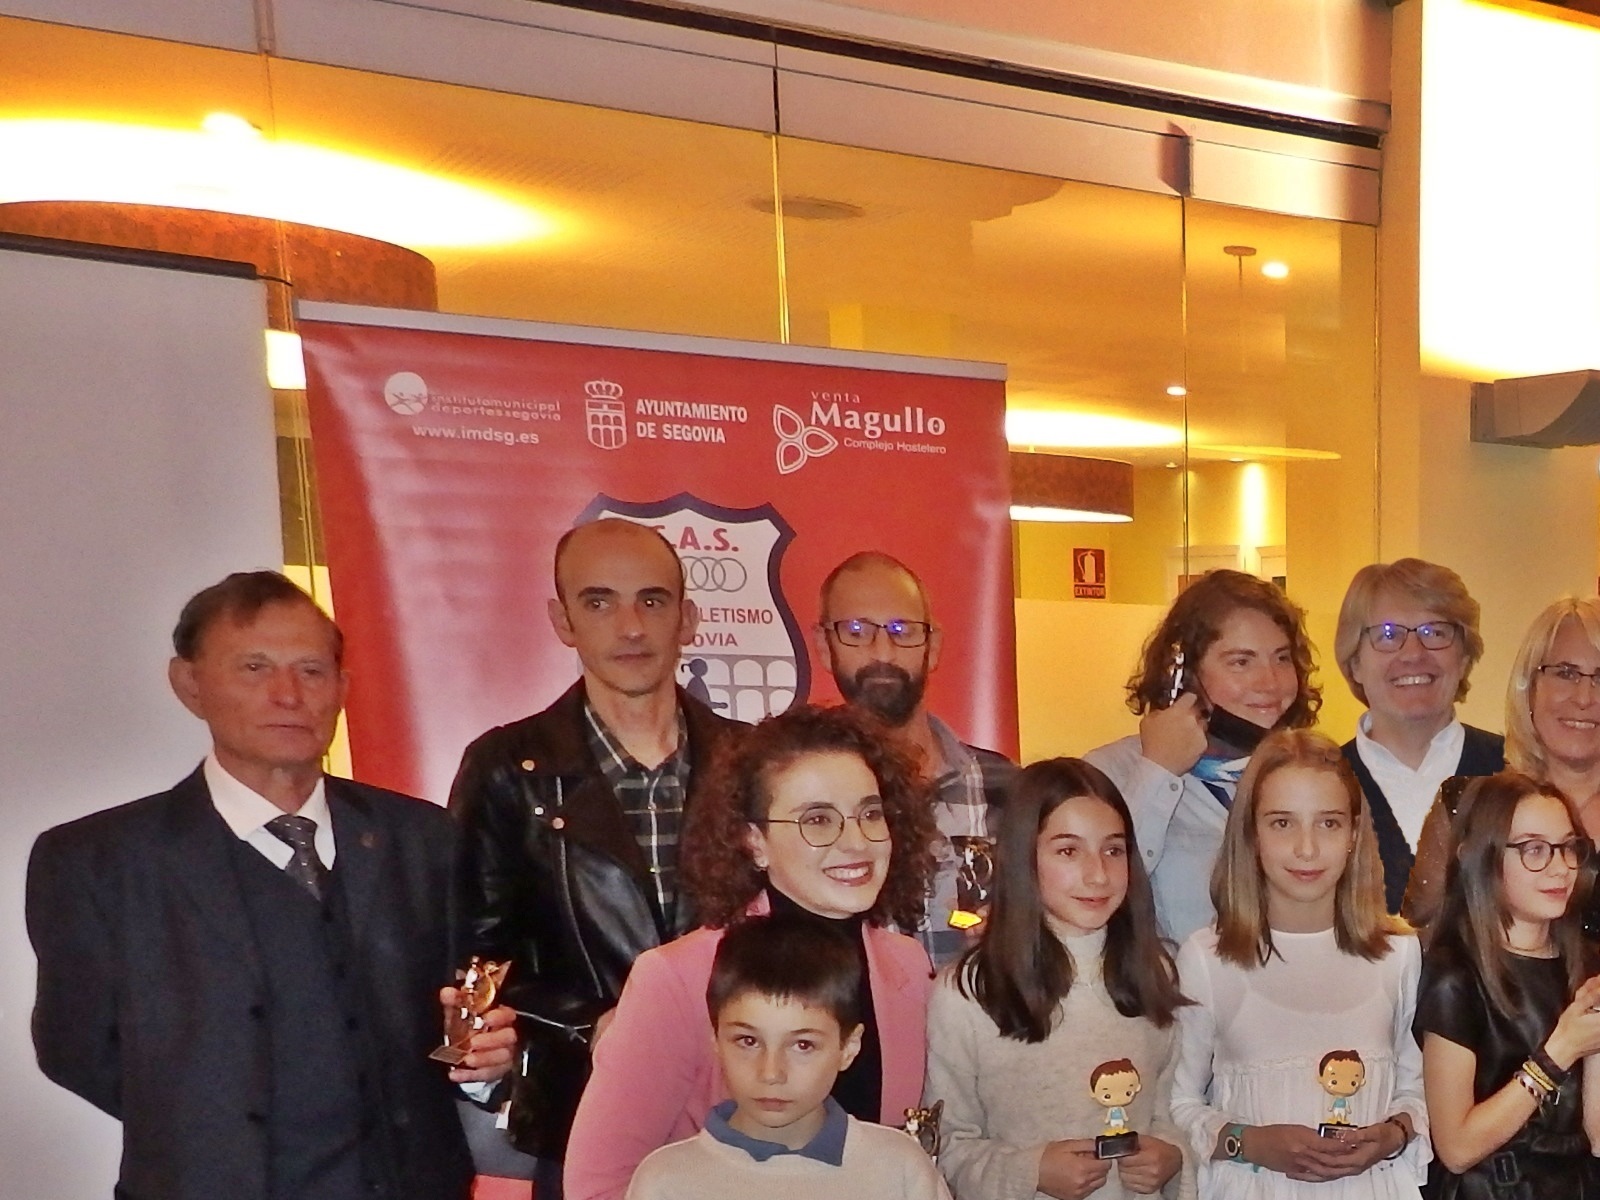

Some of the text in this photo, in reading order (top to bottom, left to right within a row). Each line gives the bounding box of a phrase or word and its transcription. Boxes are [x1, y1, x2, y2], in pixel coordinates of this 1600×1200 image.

[810, 390, 861, 404] venta
[636, 398, 748, 423] AYUNTAMIENTO
[810, 401, 946, 439] Magullo
[412, 423, 540, 446] www.imdsg.es
[636, 422, 726, 444] DE SEGOVIA
[843, 437, 947, 454] Complejo Hostelero
[699, 607, 773, 625] LETISMO
[693, 631, 738, 648] OVIA
